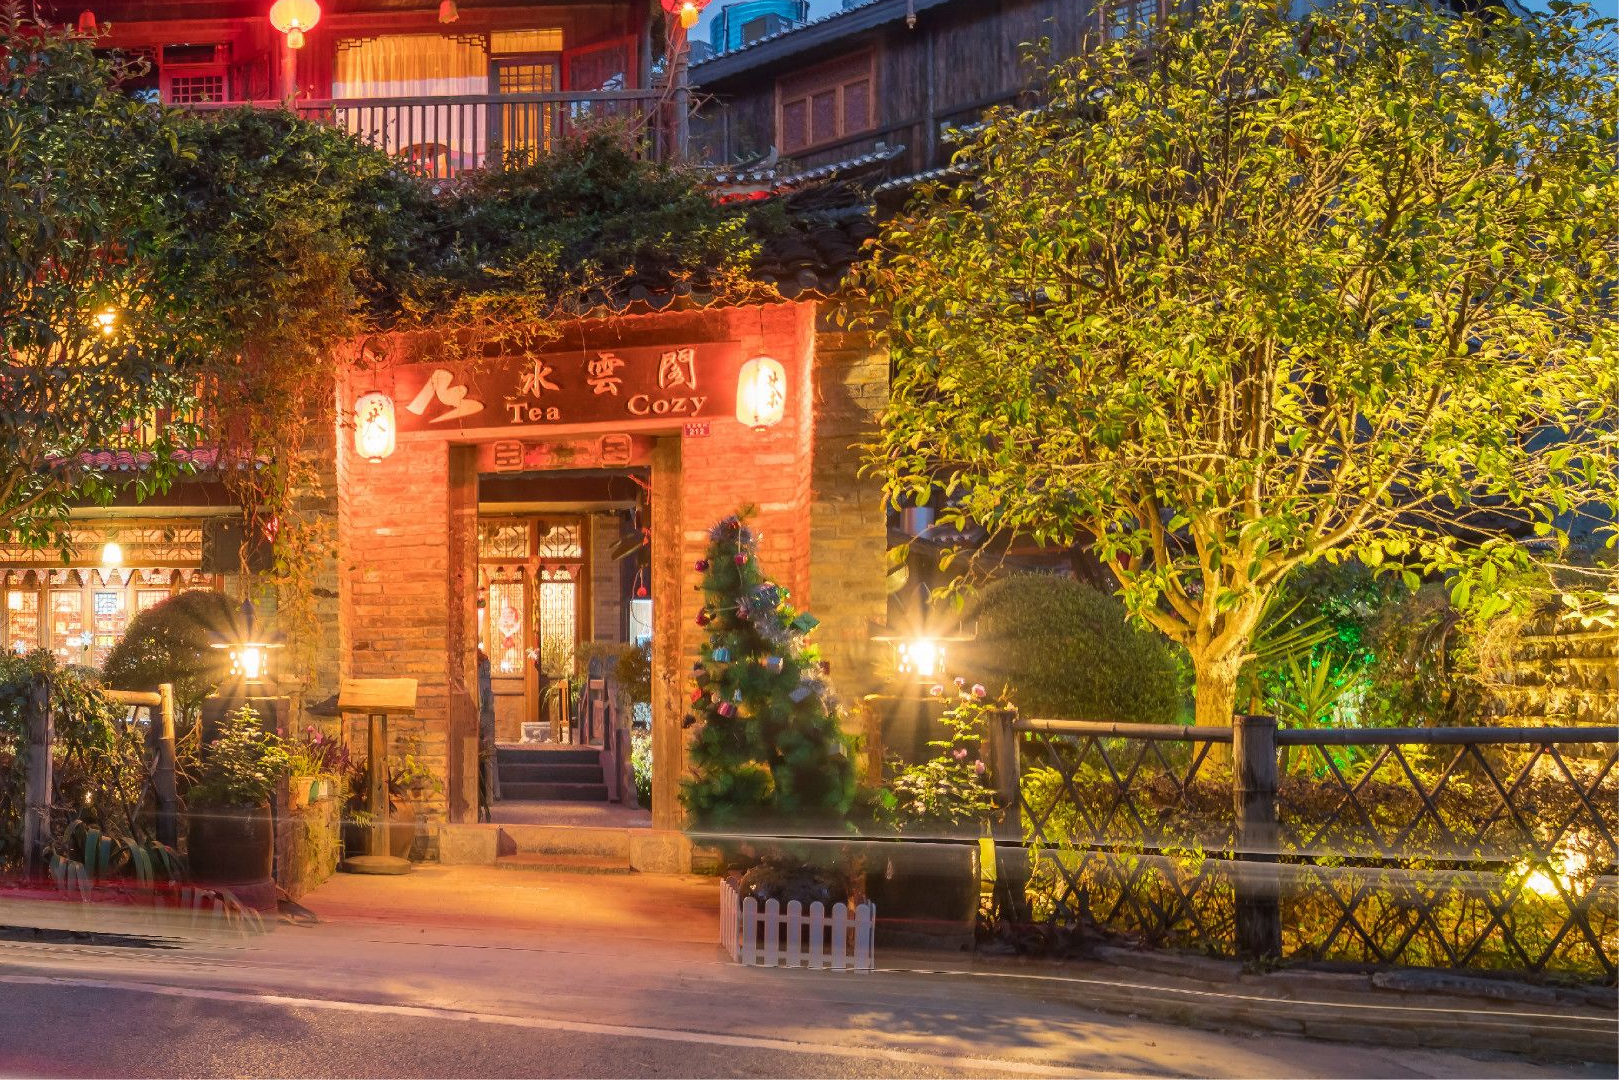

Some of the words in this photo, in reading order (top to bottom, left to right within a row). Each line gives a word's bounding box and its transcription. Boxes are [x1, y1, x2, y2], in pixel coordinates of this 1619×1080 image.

[506, 401, 561, 424] Tea
[627, 394, 707, 417] Cozy
[689, 428, 704, 436] 212
